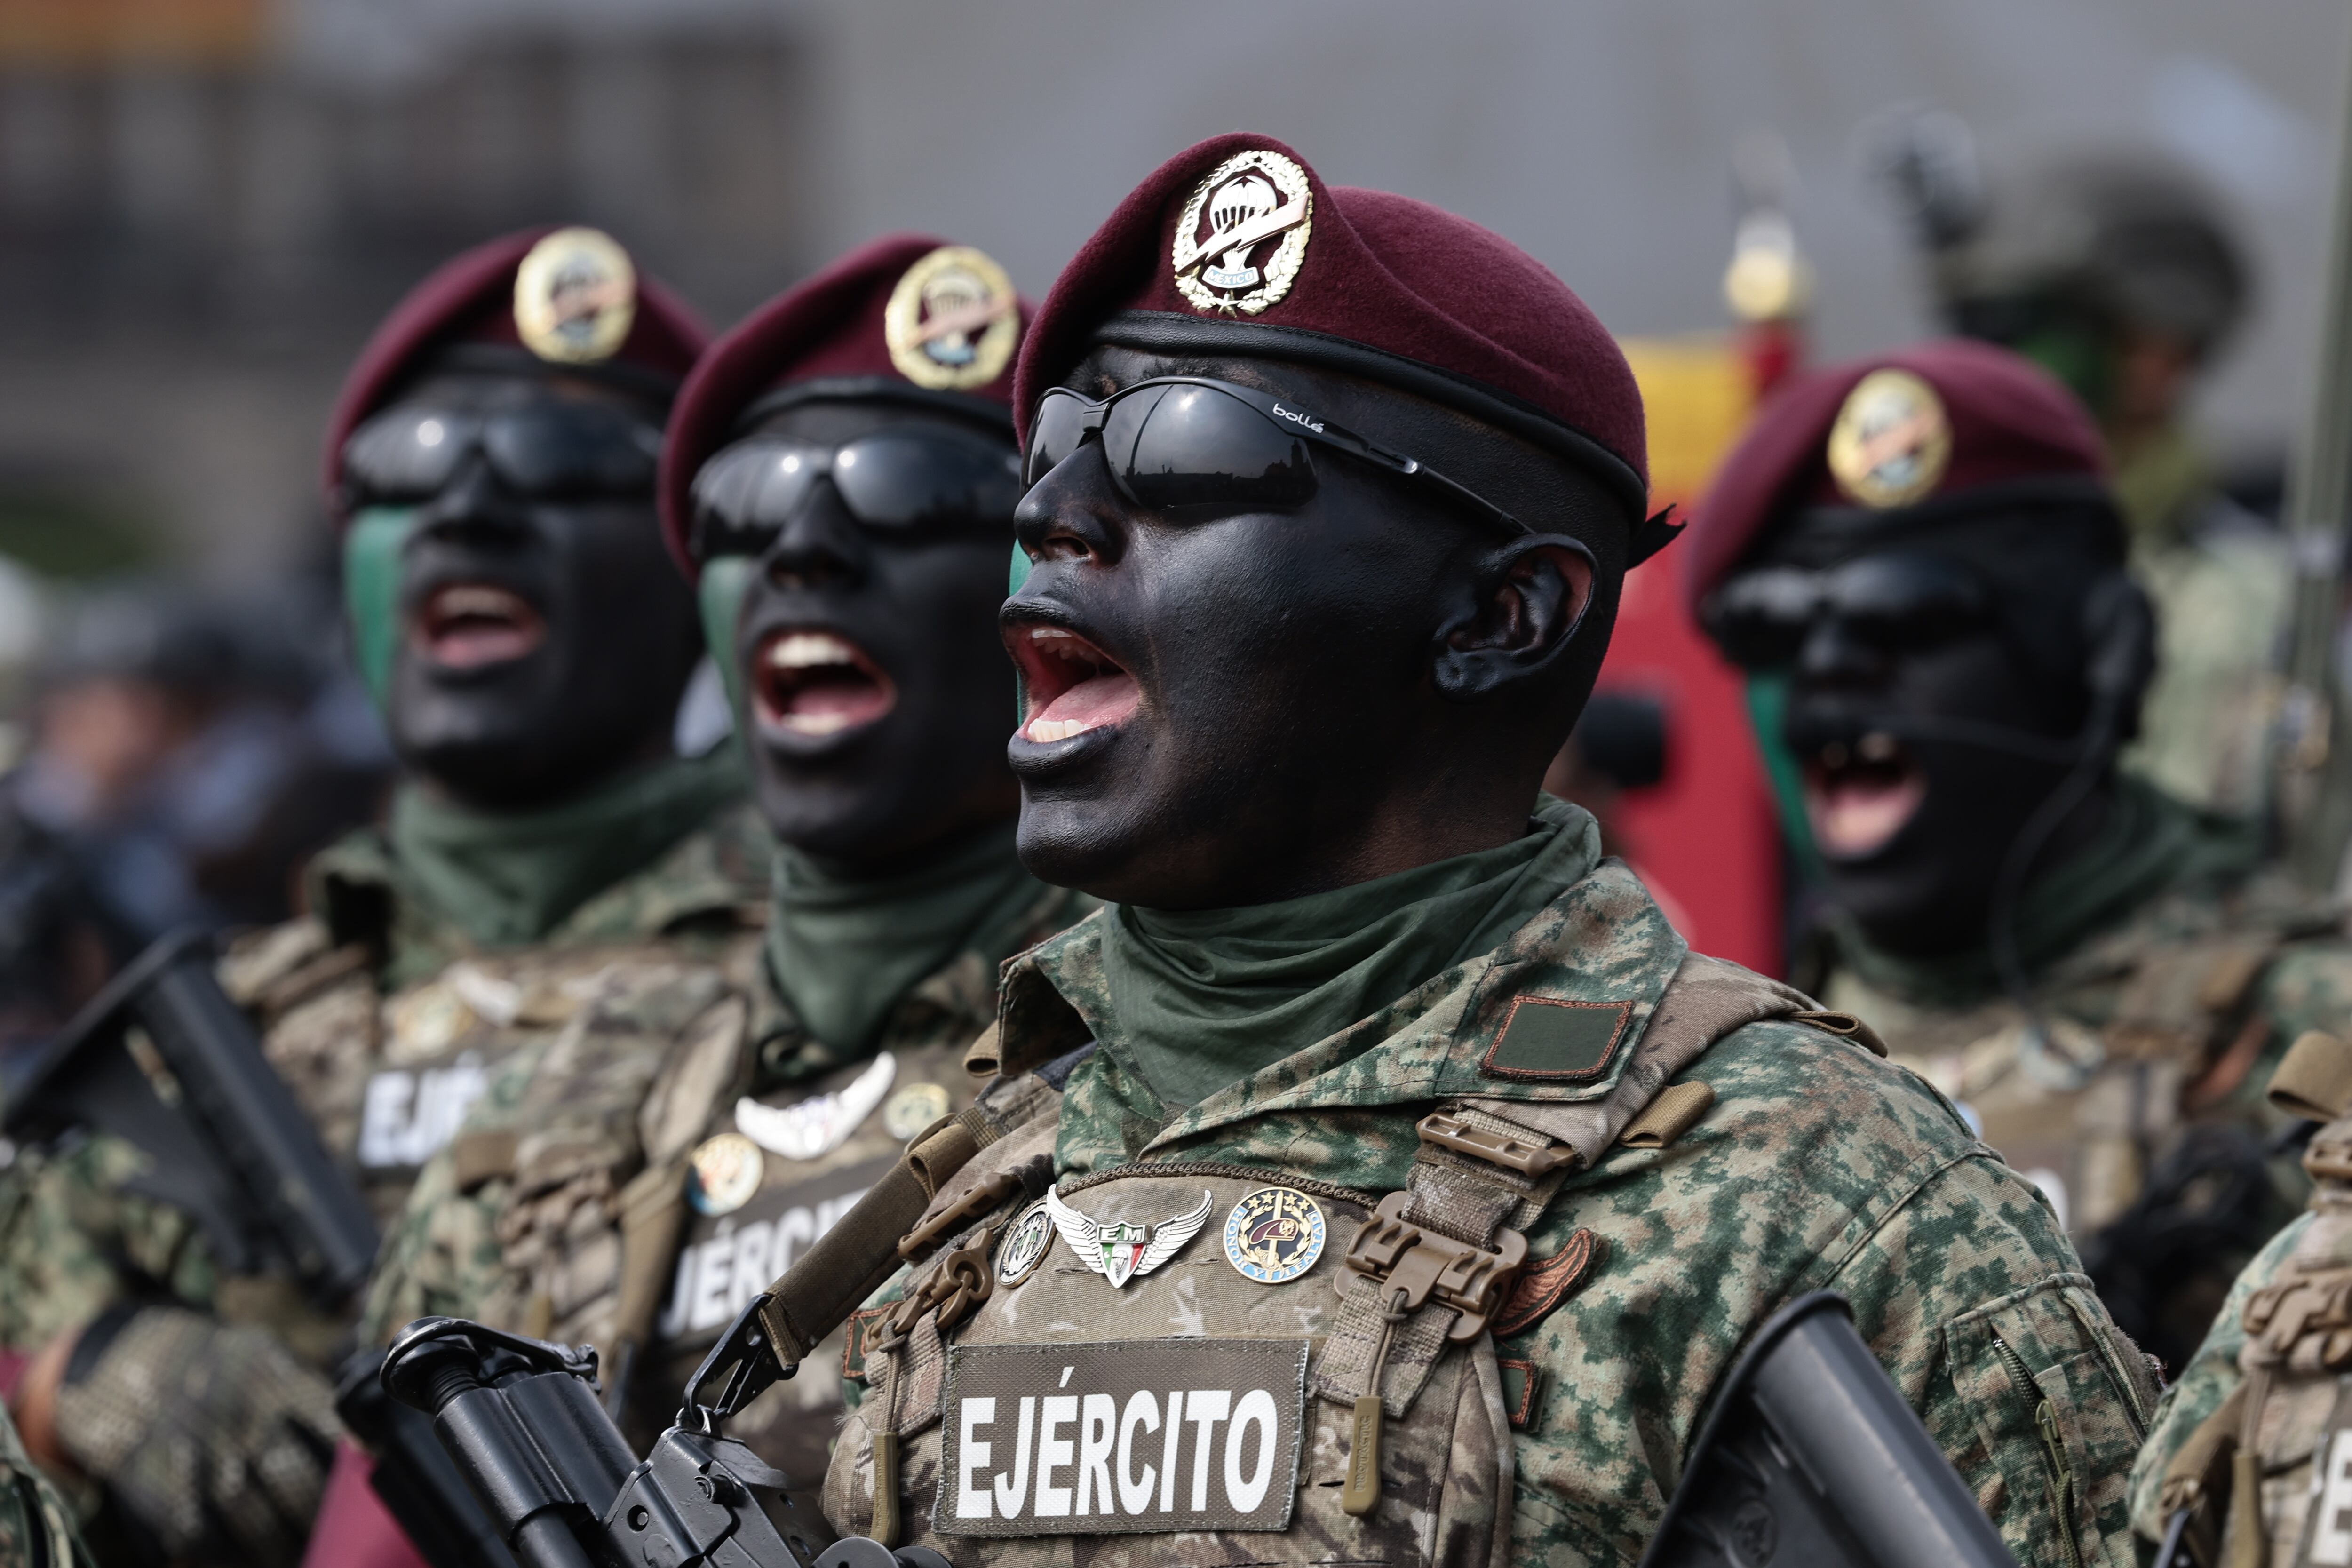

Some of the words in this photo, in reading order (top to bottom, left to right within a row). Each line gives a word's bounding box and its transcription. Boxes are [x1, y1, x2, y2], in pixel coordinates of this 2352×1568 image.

[1207, 271, 1253, 284] MEXICO
[1272, 403, 1324, 433] bollé
[1225, 1209, 1248, 1268] HONOR
[1285, 1213, 1321, 1276] LEALTAD
[955, 1367, 1278, 1520] EJÉRCITO
[1354, 1415, 1372, 1492] PROTACTIC
